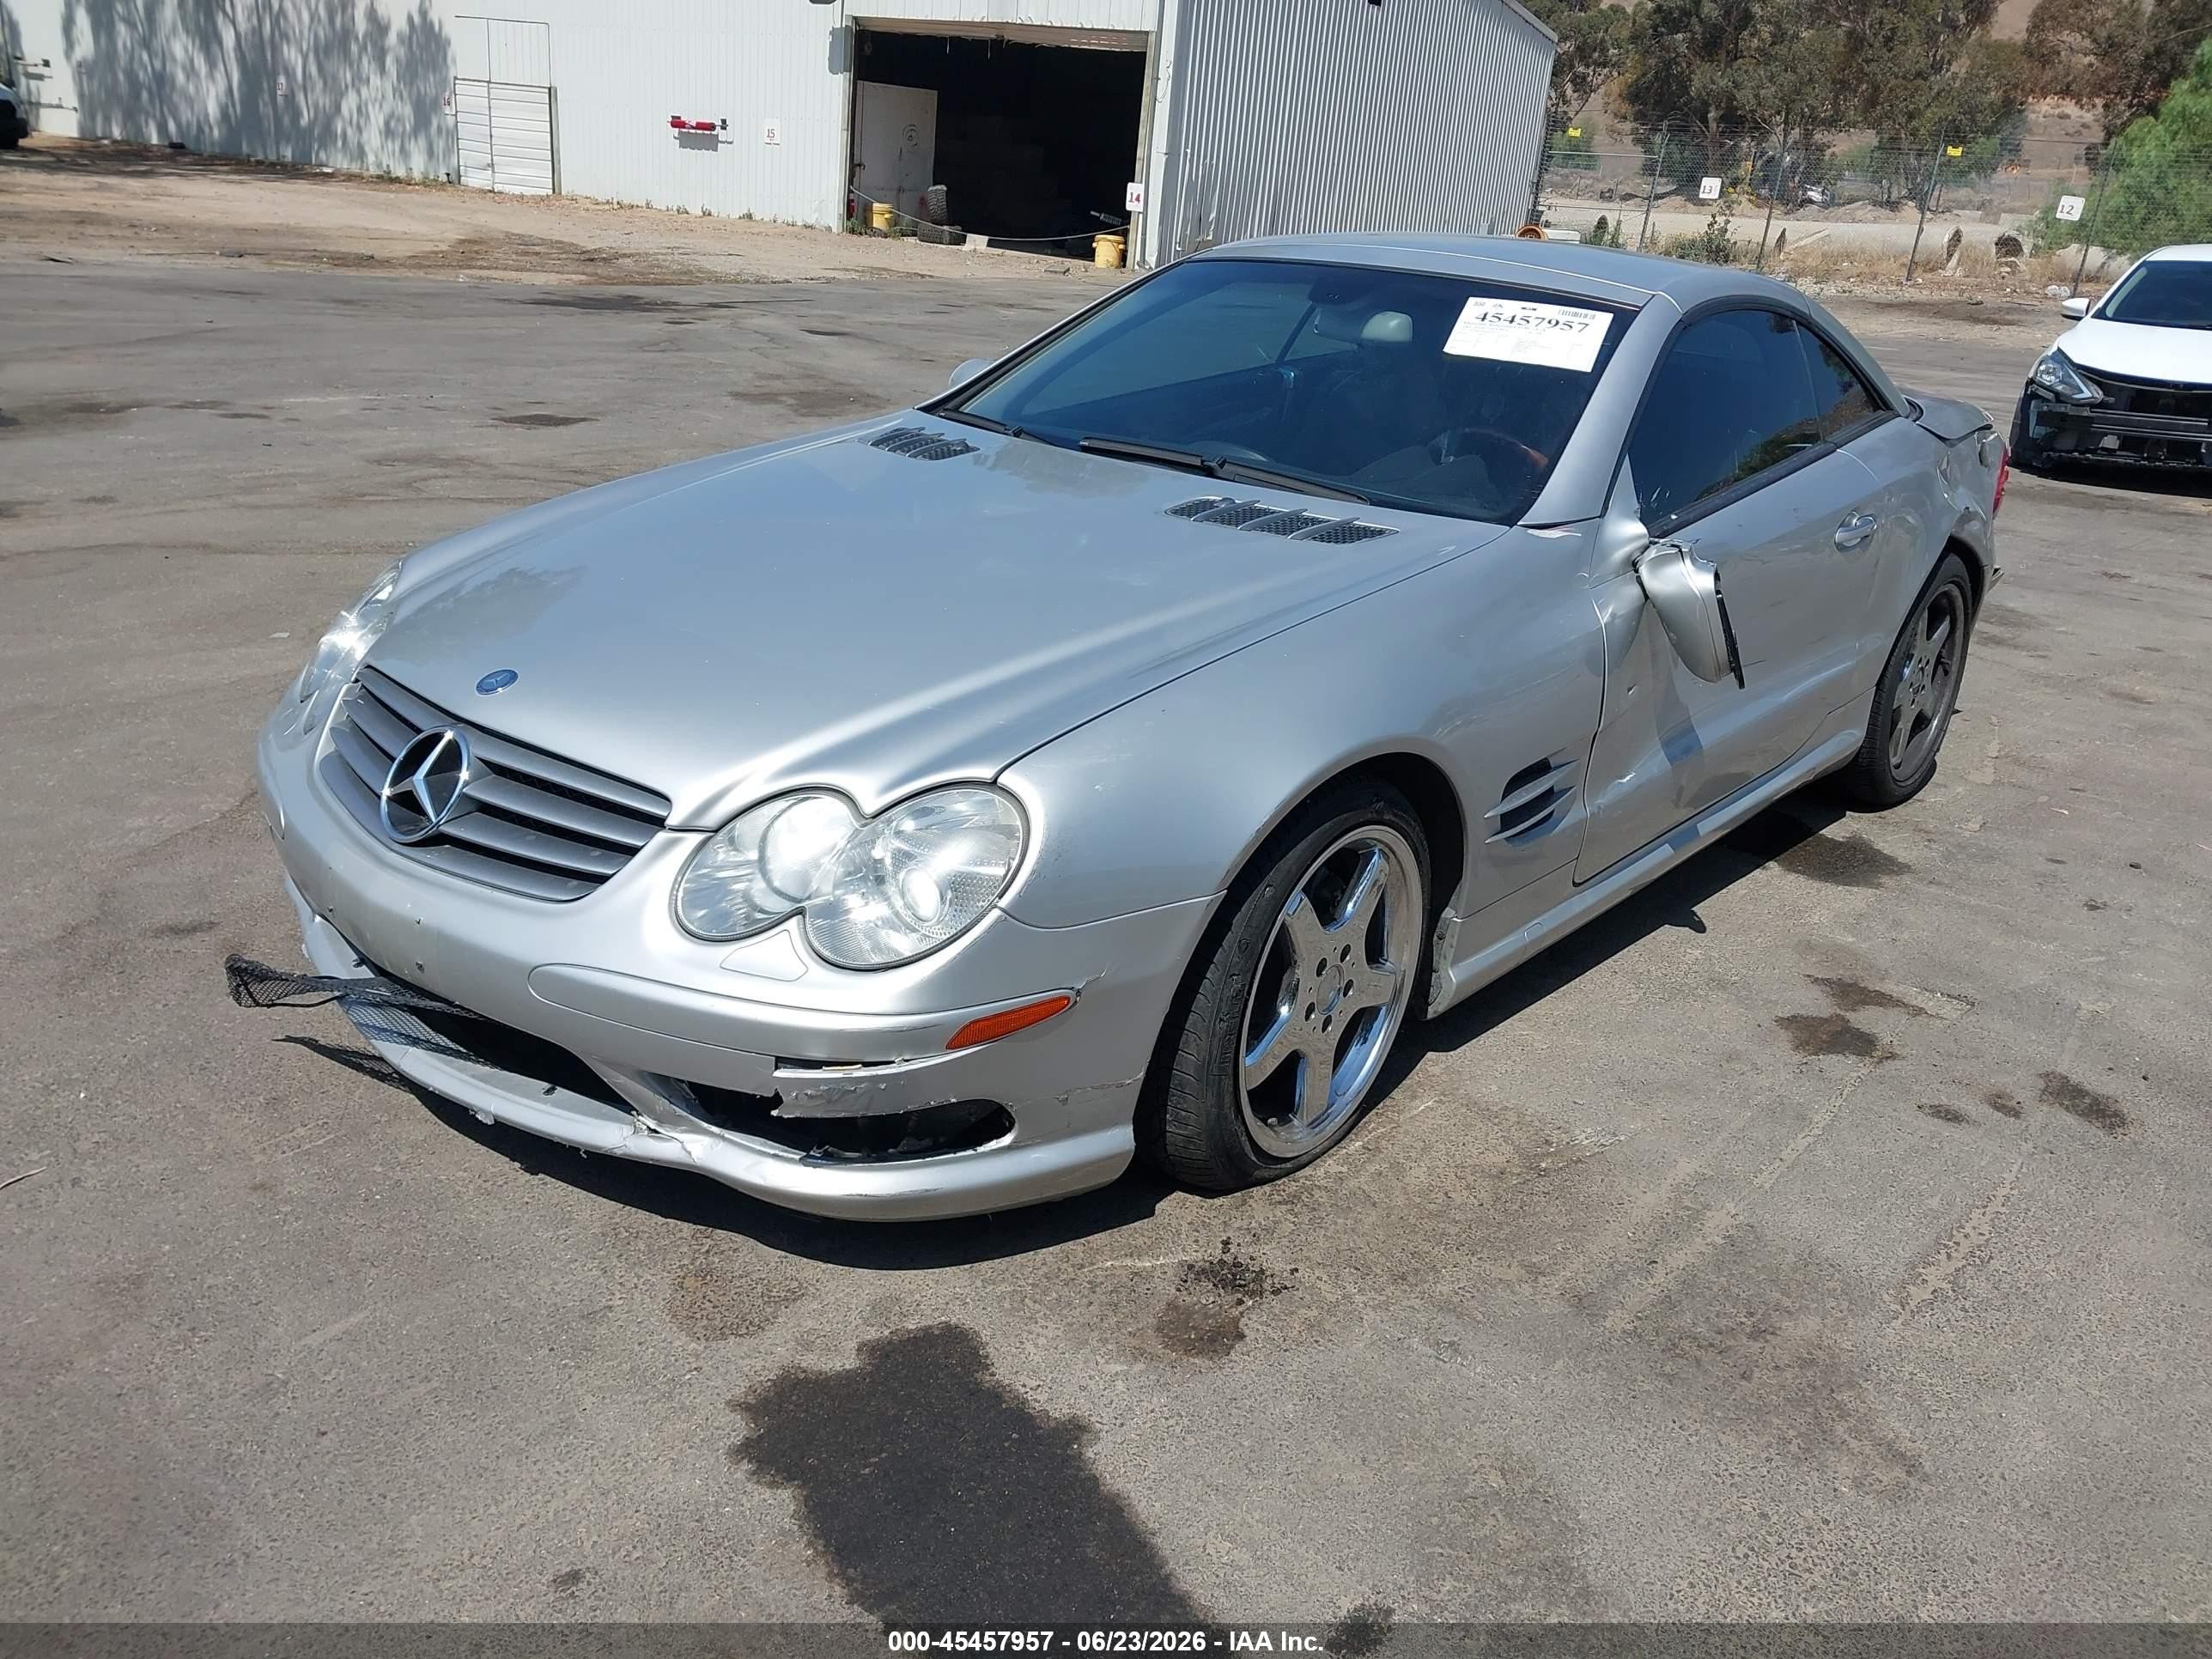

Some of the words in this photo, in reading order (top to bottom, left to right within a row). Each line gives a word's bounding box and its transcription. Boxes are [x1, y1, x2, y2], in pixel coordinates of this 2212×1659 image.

[767, 128, 775, 138] 15
[1127, 191, 1141, 204] 14
[2059, 204, 2075, 216] 12
[1474, 311, 1590, 333] 45457957
